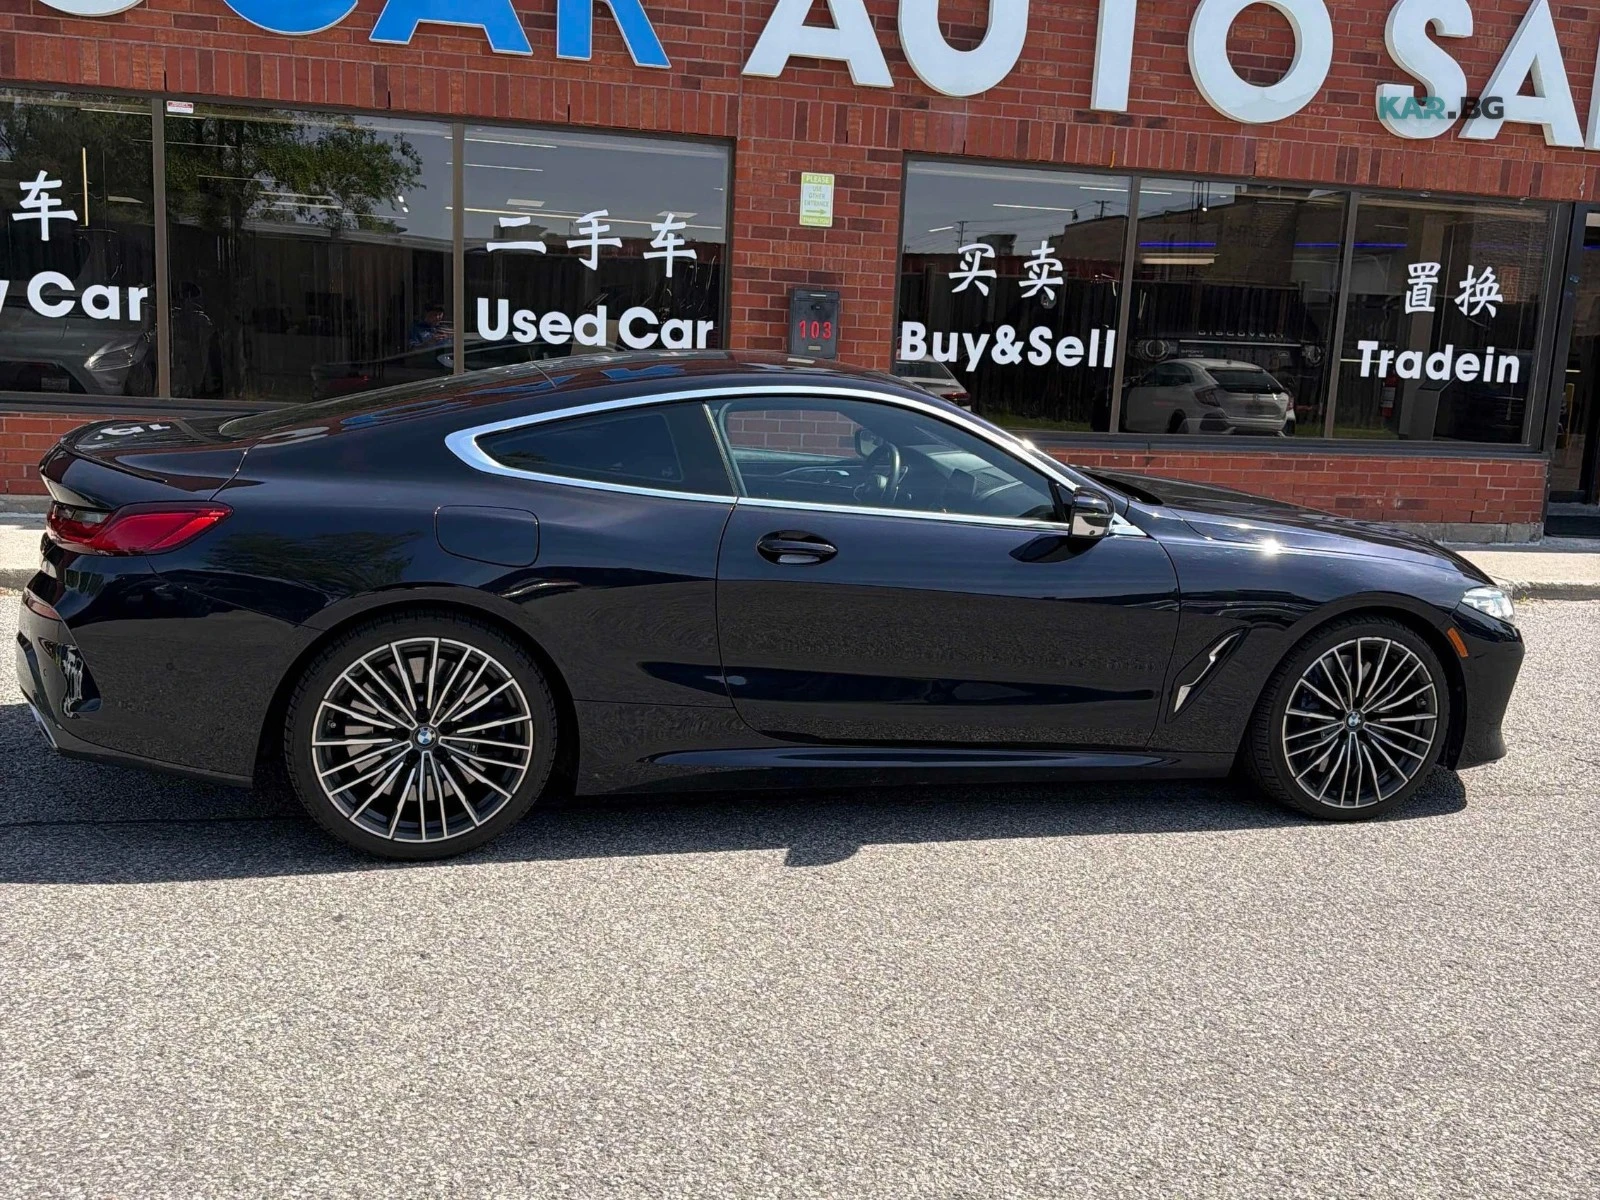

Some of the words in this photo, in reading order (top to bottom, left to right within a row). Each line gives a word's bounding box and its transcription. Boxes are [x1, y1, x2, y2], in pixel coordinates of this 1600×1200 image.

[1376, 0, 1600, 150] SA
[12, 169, 78, 242] 车
[806, 175, 830, 184] PLEASE
[486, 209, 698, 278] 二手车
[27, 270, 148, 322] Car
[948, 240, 1064, 300] 买卖
[1404, 261, 1504, 319] 置换
[477, 297, 607, 347] Used
[618, 306, 714, 349] Car
[799, 320, 832, 339] 103
[900, 320, 1116, 372] Buy&Sell
[1357, 340, 1520, 384] Tradein
